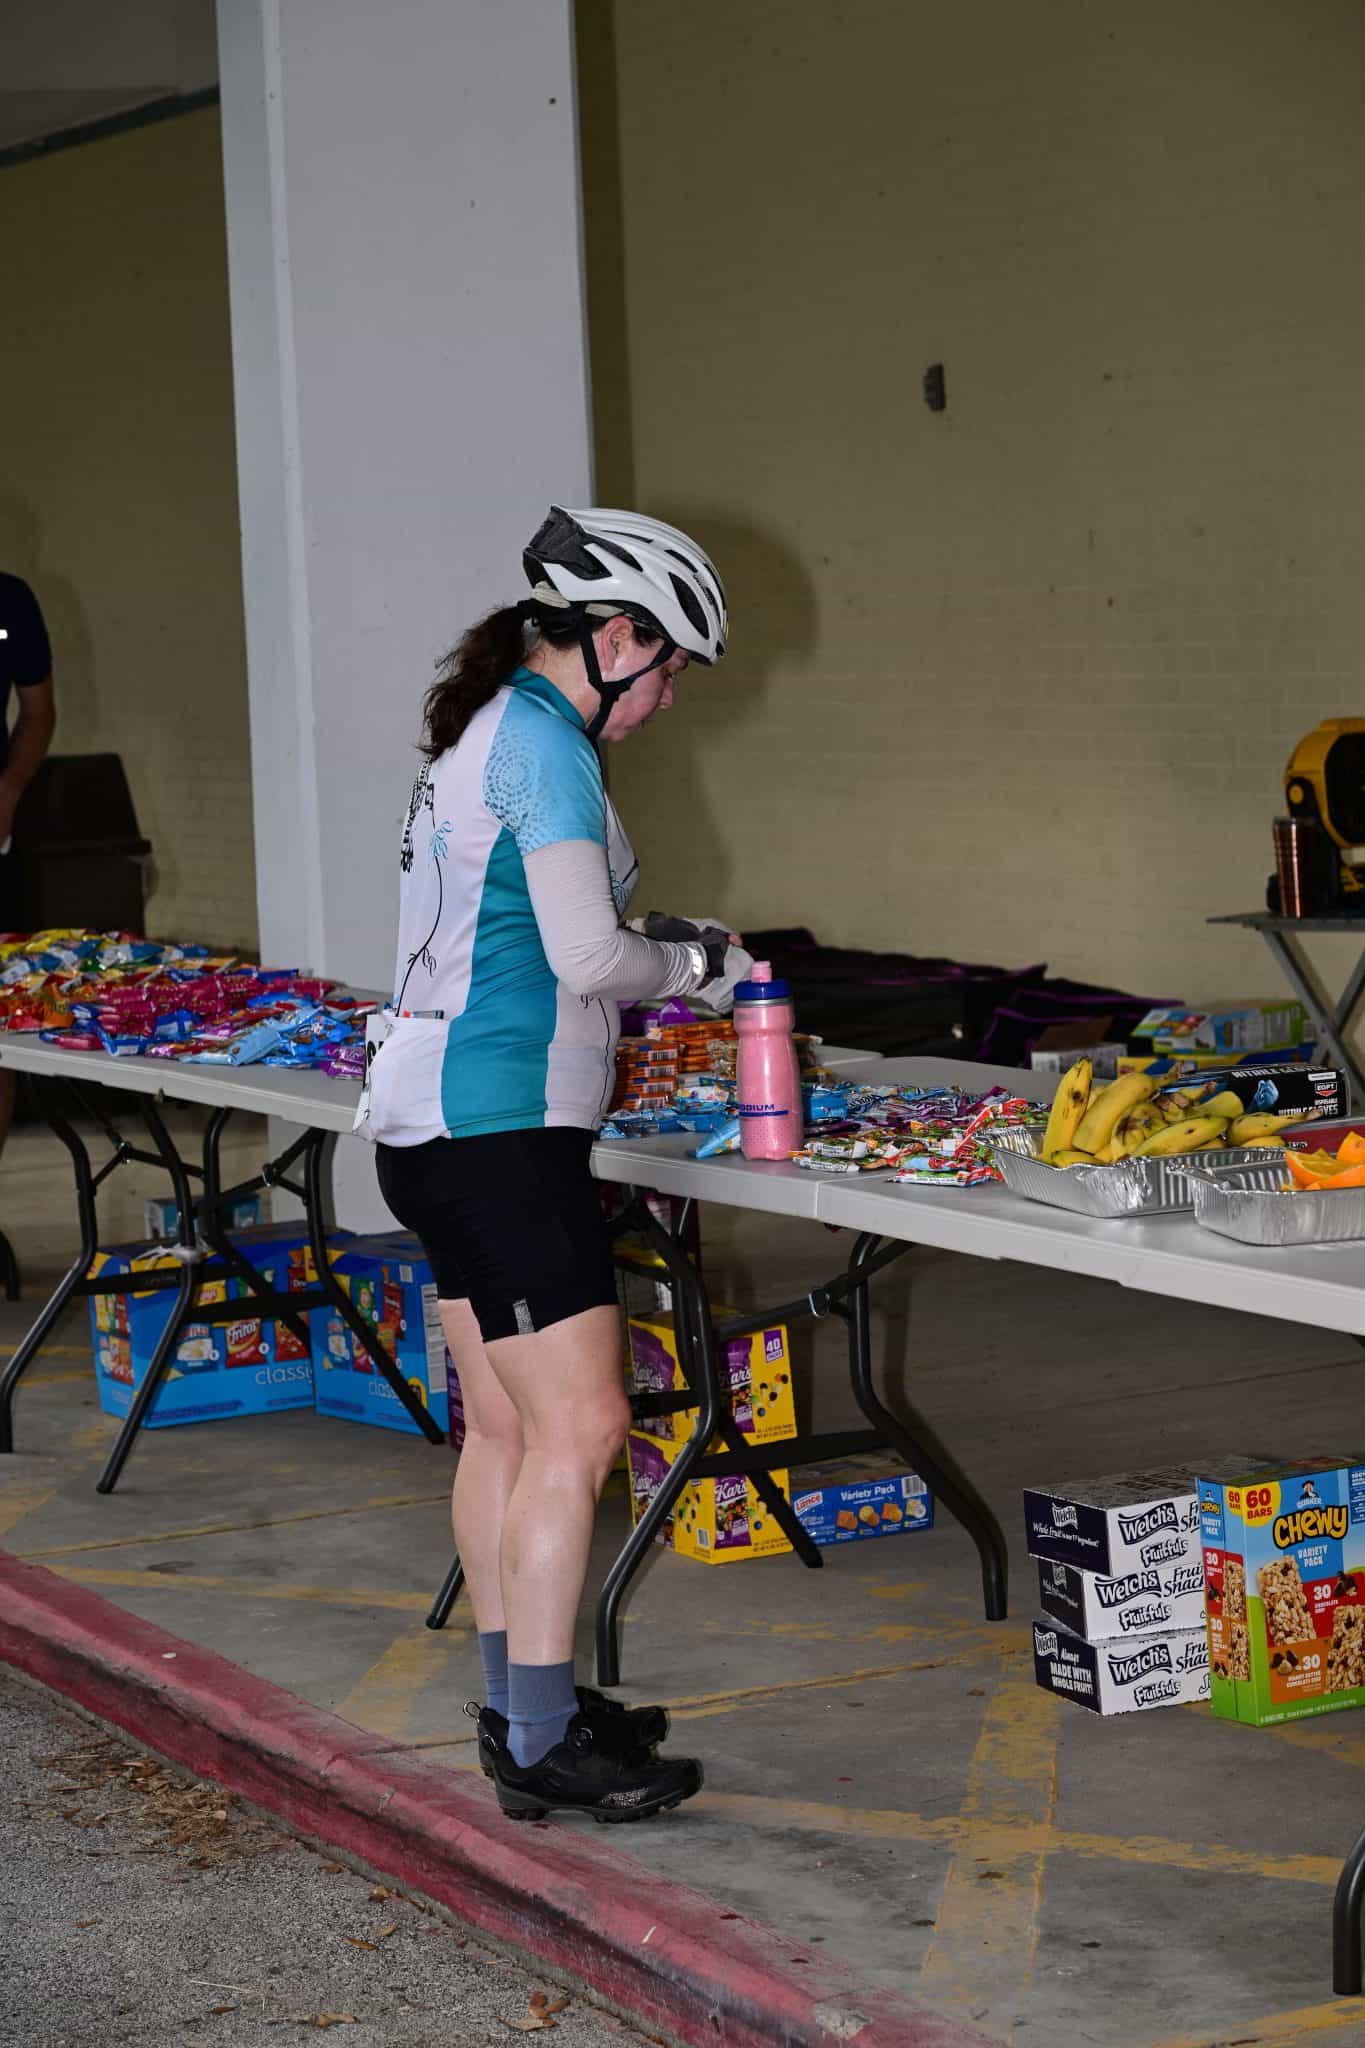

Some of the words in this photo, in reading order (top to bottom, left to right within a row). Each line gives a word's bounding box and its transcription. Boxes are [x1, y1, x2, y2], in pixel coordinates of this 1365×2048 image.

[228, 1320, 257, 1345] Fritos
[766, 1338, 781, 1352] 40
[729, 1365, 752, 1385] ar's
[840, 1489, 873, 1502] Variety
[874, 1484, 896, 1495] Pack
[1246, 1487, 1272, 1509] 60
[1247, 1507, 1273, 1519] BARS
[1119, 1504, 1176, 1542] Welch's
[1206, 1552, 1219, 1566] 30
[1298, 1545, 1328, 1559] VARIETY
[1304, 1556, 1323, 1568] PACK
[1098, 1571, 1158, 1605] Welch's
[1313, 1583, 1332, 1601] 30
[1184, 1641, 1208, 1657] Fru
[1110, 1646, 1169, 1682] Welch's
[1175, 1650, 1209, 1673] Snac
[1302, 1653, 1321, 1670] 30
[1050, 1661, 1073, 1679] MADE
[1072, 1666, 1092, 1683] WITH
[1051, 1675, 1073, 1691] WHOLE
